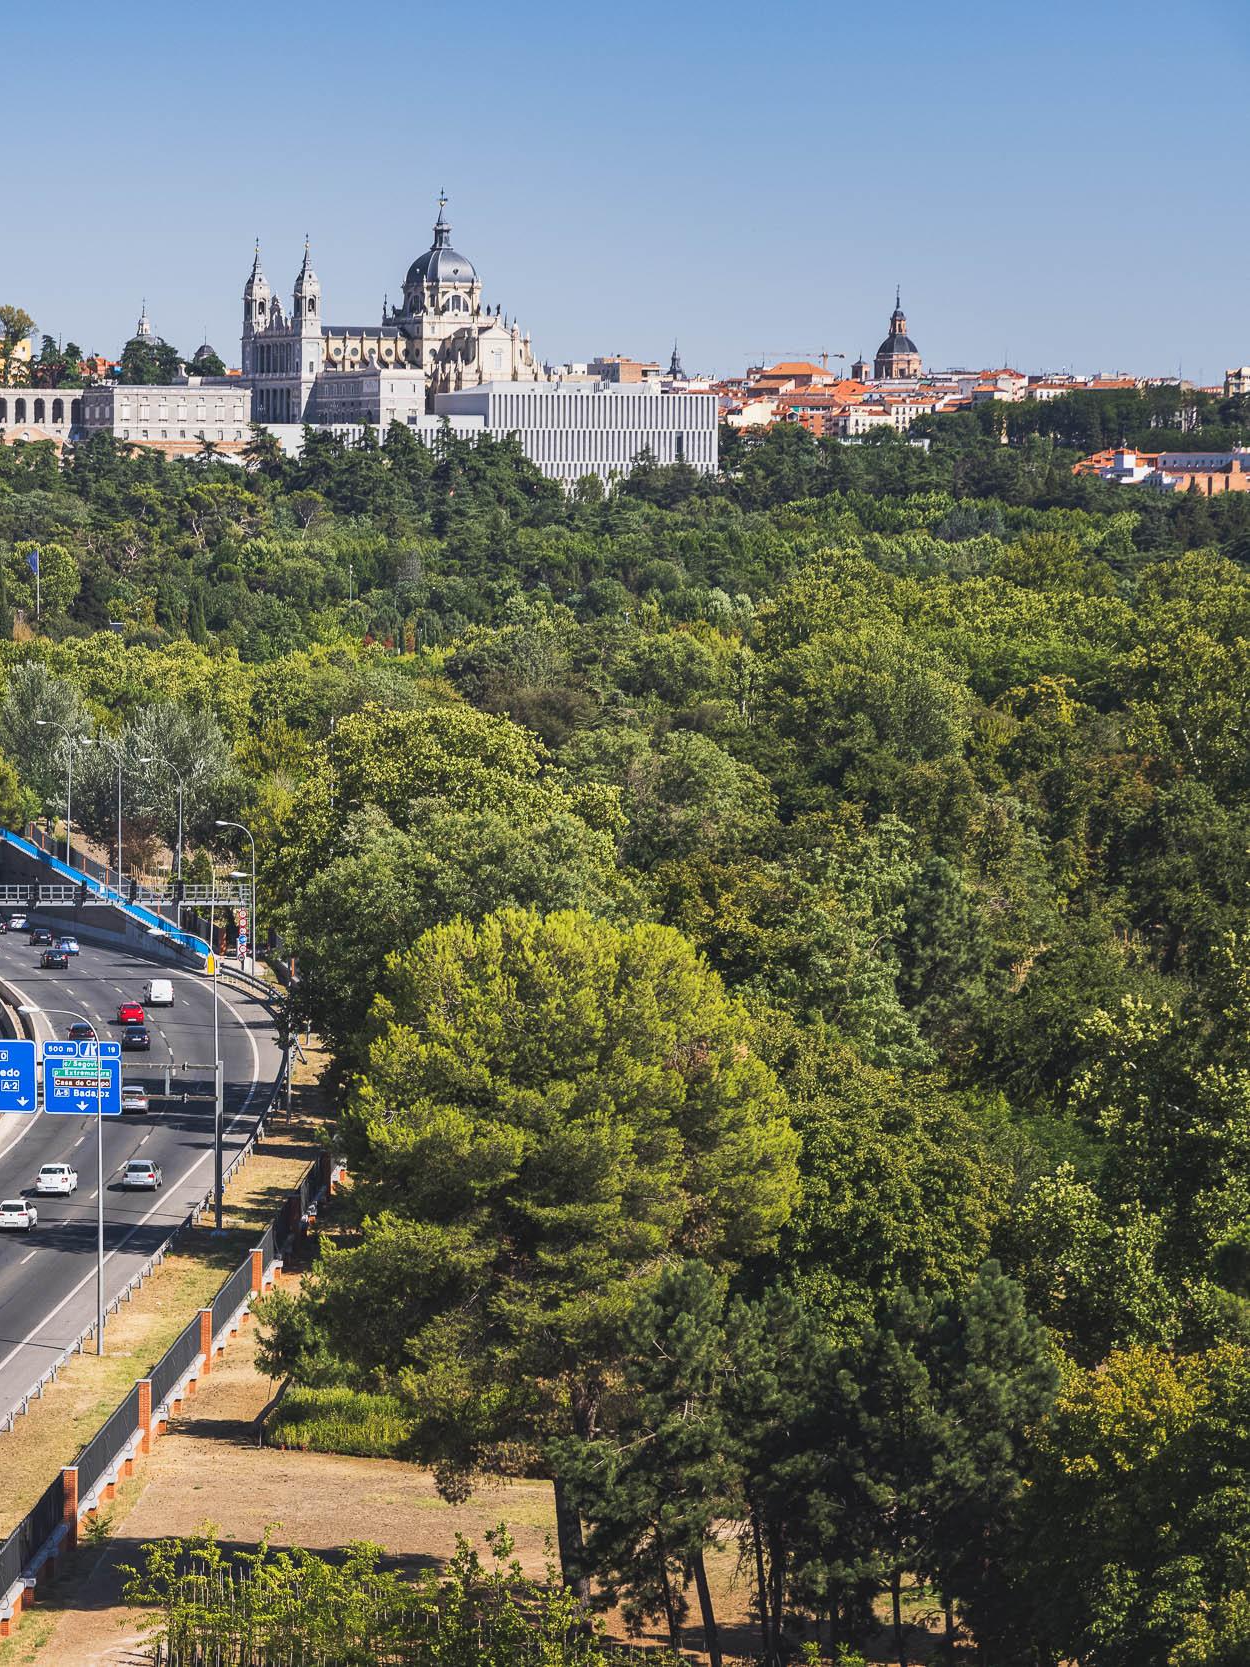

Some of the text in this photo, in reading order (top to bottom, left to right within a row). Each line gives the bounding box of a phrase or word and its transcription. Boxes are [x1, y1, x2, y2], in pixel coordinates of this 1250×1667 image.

[73, 1060, 101, 1068] Segovi
[2, 1081, 18, 1090] A-2
[73, 1089, 110, 1098] Badajoz
